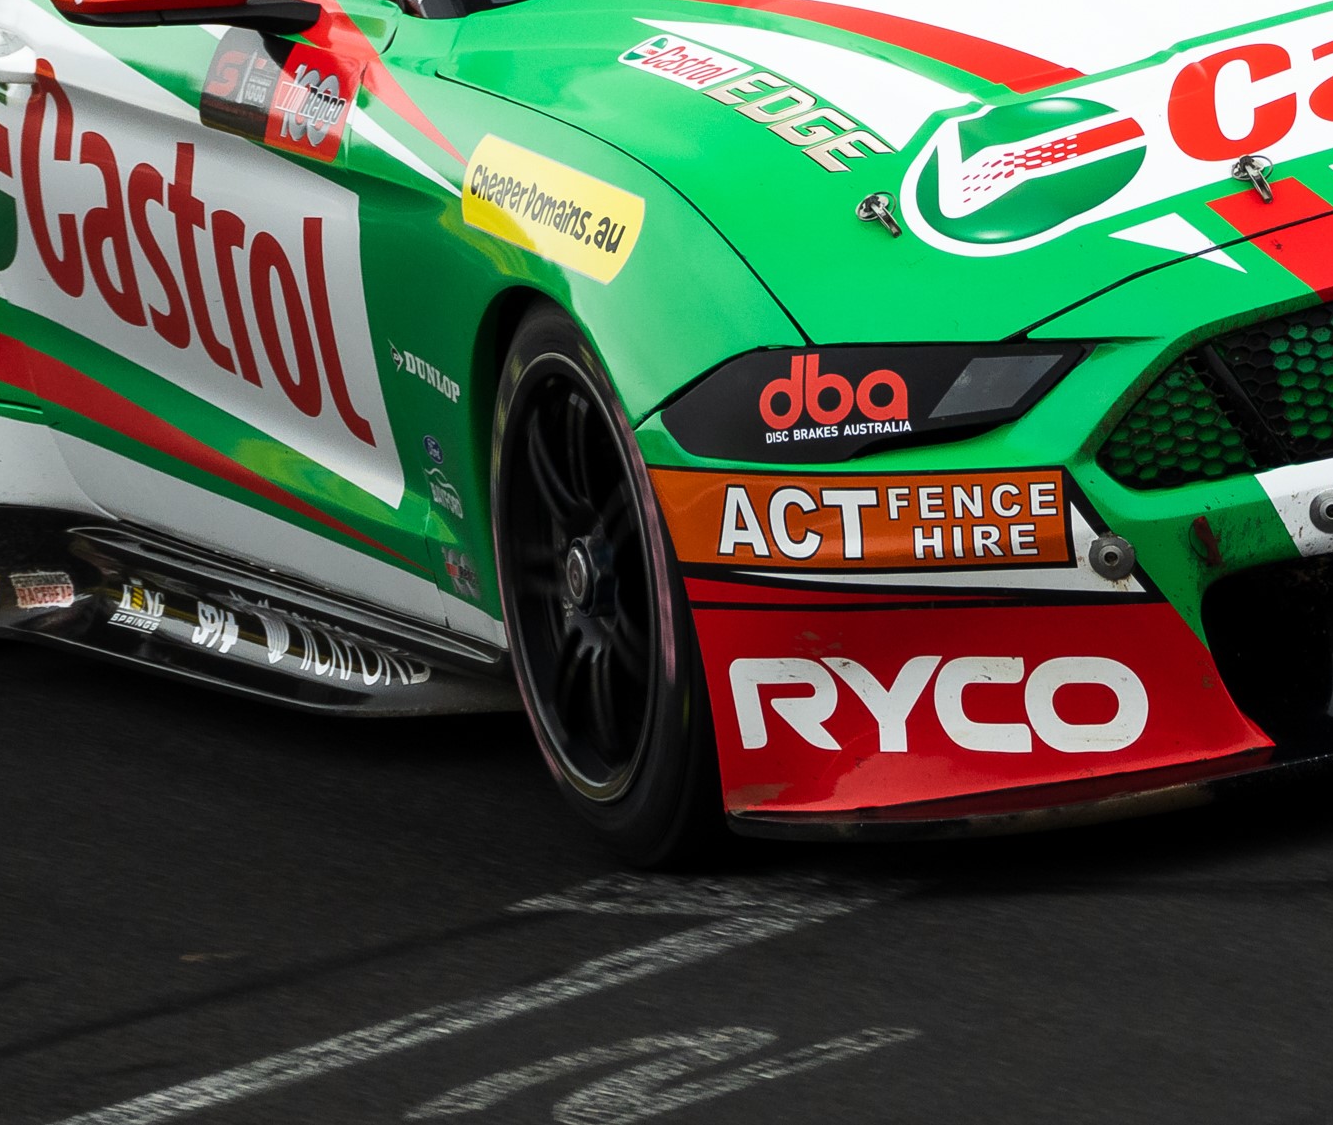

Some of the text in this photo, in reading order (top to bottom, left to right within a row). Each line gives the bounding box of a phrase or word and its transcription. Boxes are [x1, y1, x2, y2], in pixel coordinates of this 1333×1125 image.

[641, 45, 739, 85] Castrol
[700, 70, 897, 174] EDGE
[20, 58, 377, 449] Castrol
[403, 350, 461, 404] DUNLOP
[759, 353, 909, 430] dba
[765, 420, 913, 444] DISC BRAKES AUSTRALIA
[719, 485, 879, 560] ACT
[887, 481, 1059, 521] FENCE
[913, 523, 1039, 560] HIRE
[109, 611, 161, 633] SPRINGS
[727, 654, 1150, 754] RYCO
